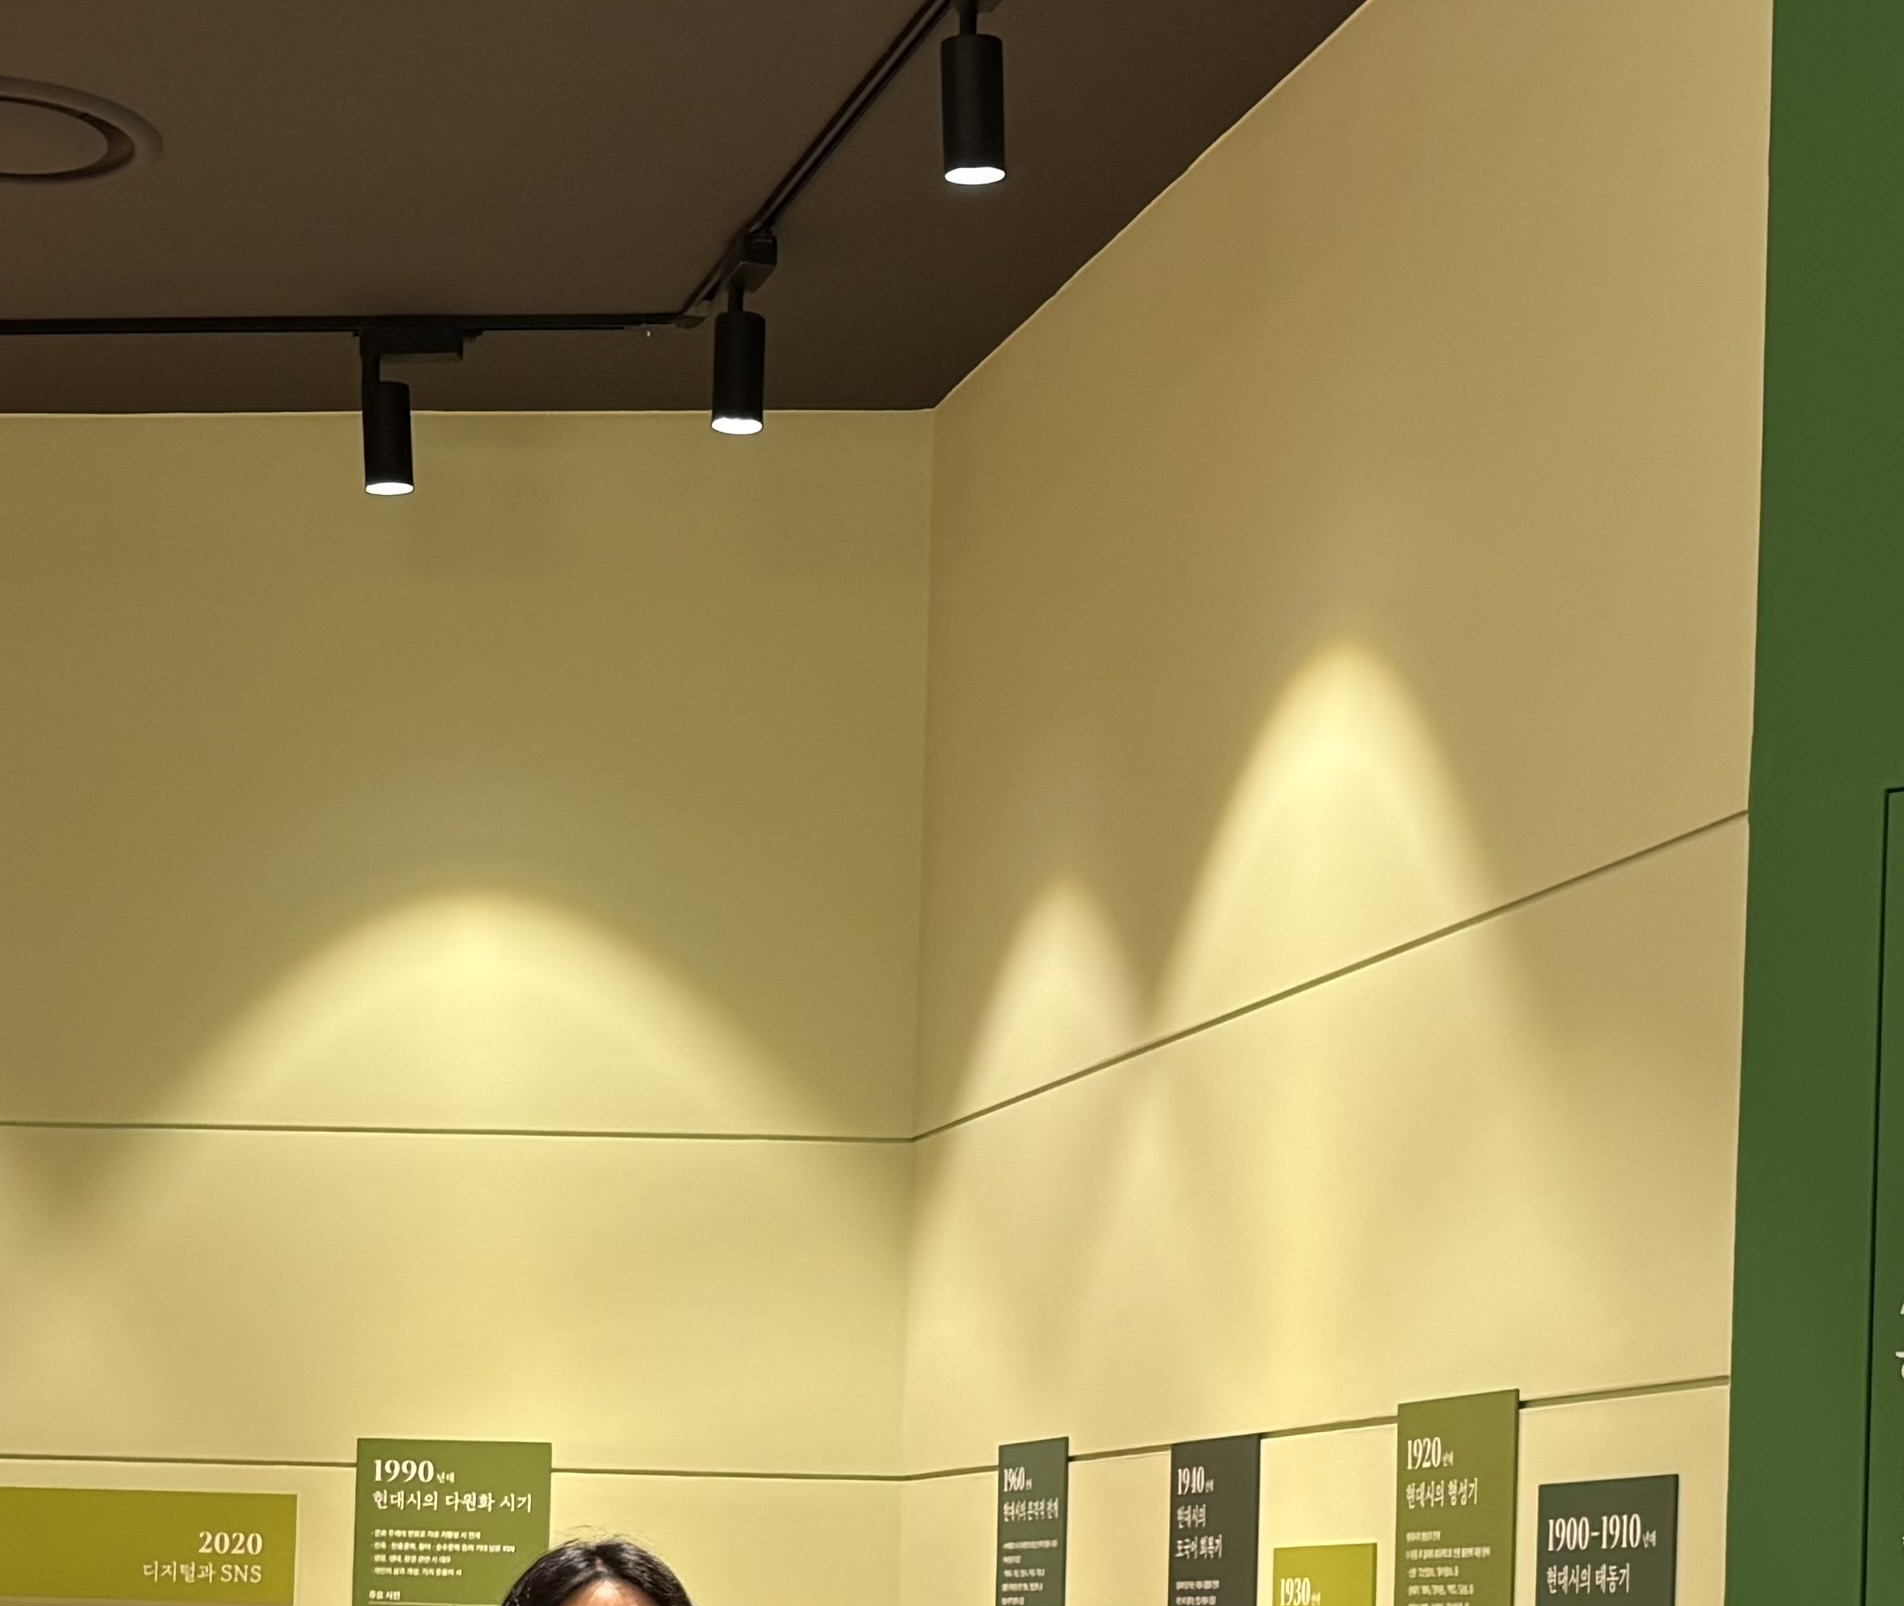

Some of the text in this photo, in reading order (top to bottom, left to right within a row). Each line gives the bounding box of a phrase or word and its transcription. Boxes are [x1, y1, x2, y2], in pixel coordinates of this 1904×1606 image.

[373, 1490, 532, 1513] 현대시의 다원화 시기
[198, 1531, 263, 1555] 2020
[143, 1561, 262, 1584] 디지털과 SNS
[1546, 1563, 1630, 1595] 현대시의 태동기
